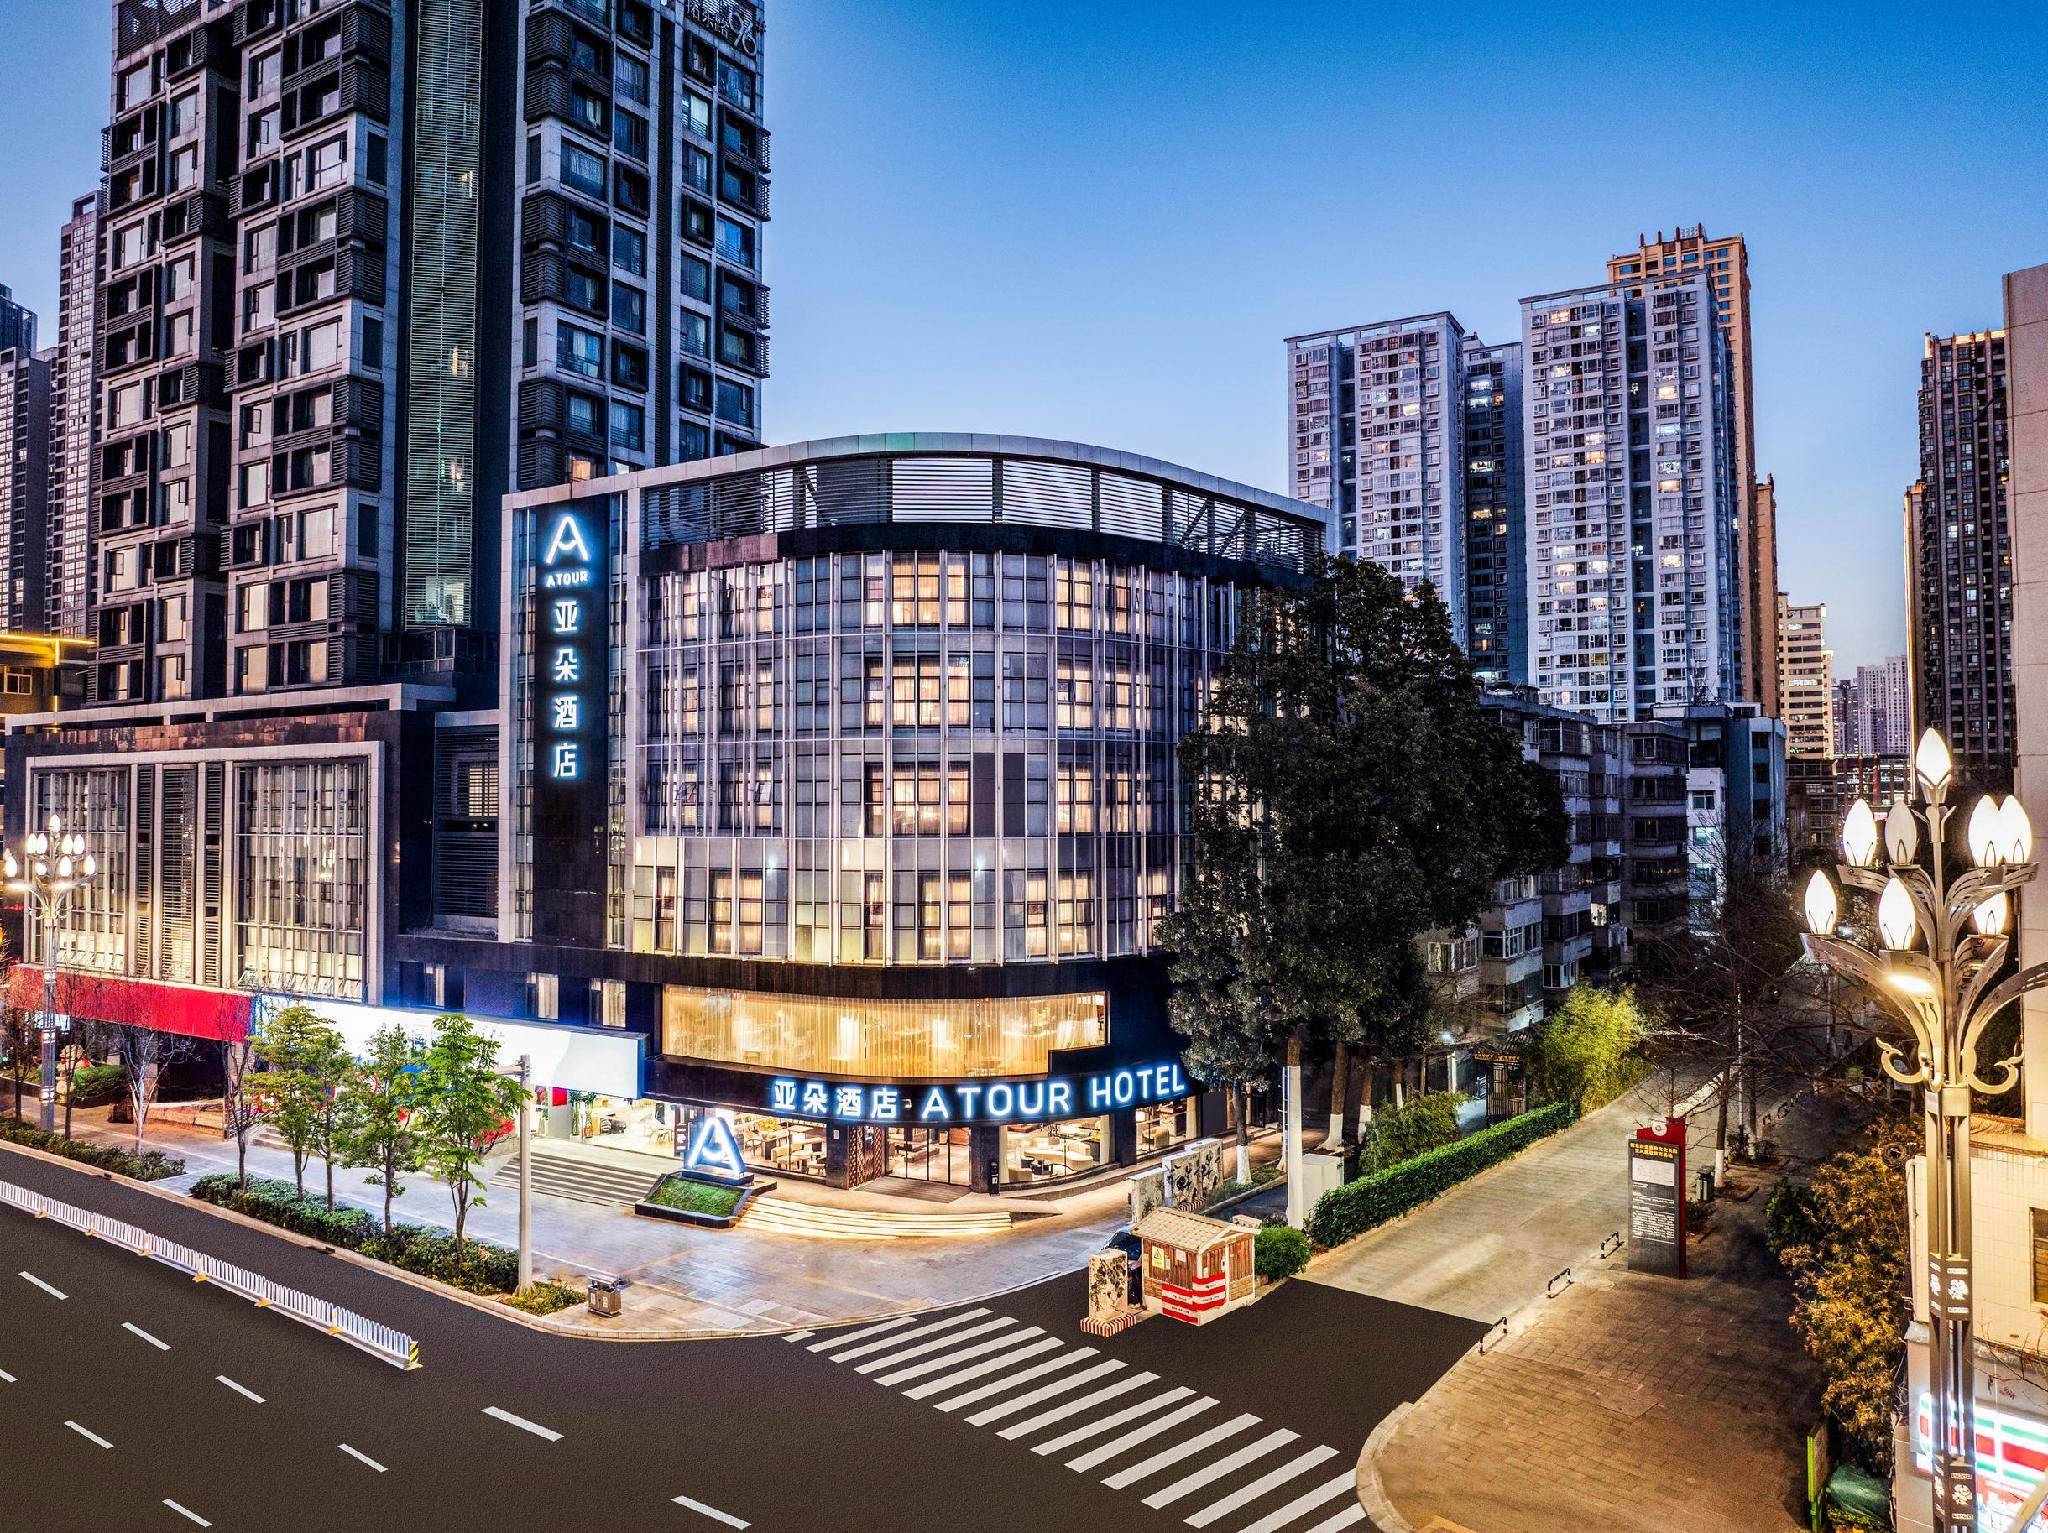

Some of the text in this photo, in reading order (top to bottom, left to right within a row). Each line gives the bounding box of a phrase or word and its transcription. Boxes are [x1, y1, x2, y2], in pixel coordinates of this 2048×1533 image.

[545, 570, 588, 587] ATOUR
[554, 600, 578, 777] 亚朵酒店
[774, 1065, 1185, 1119] 亚朵酒店 ATOUR HOTEL
